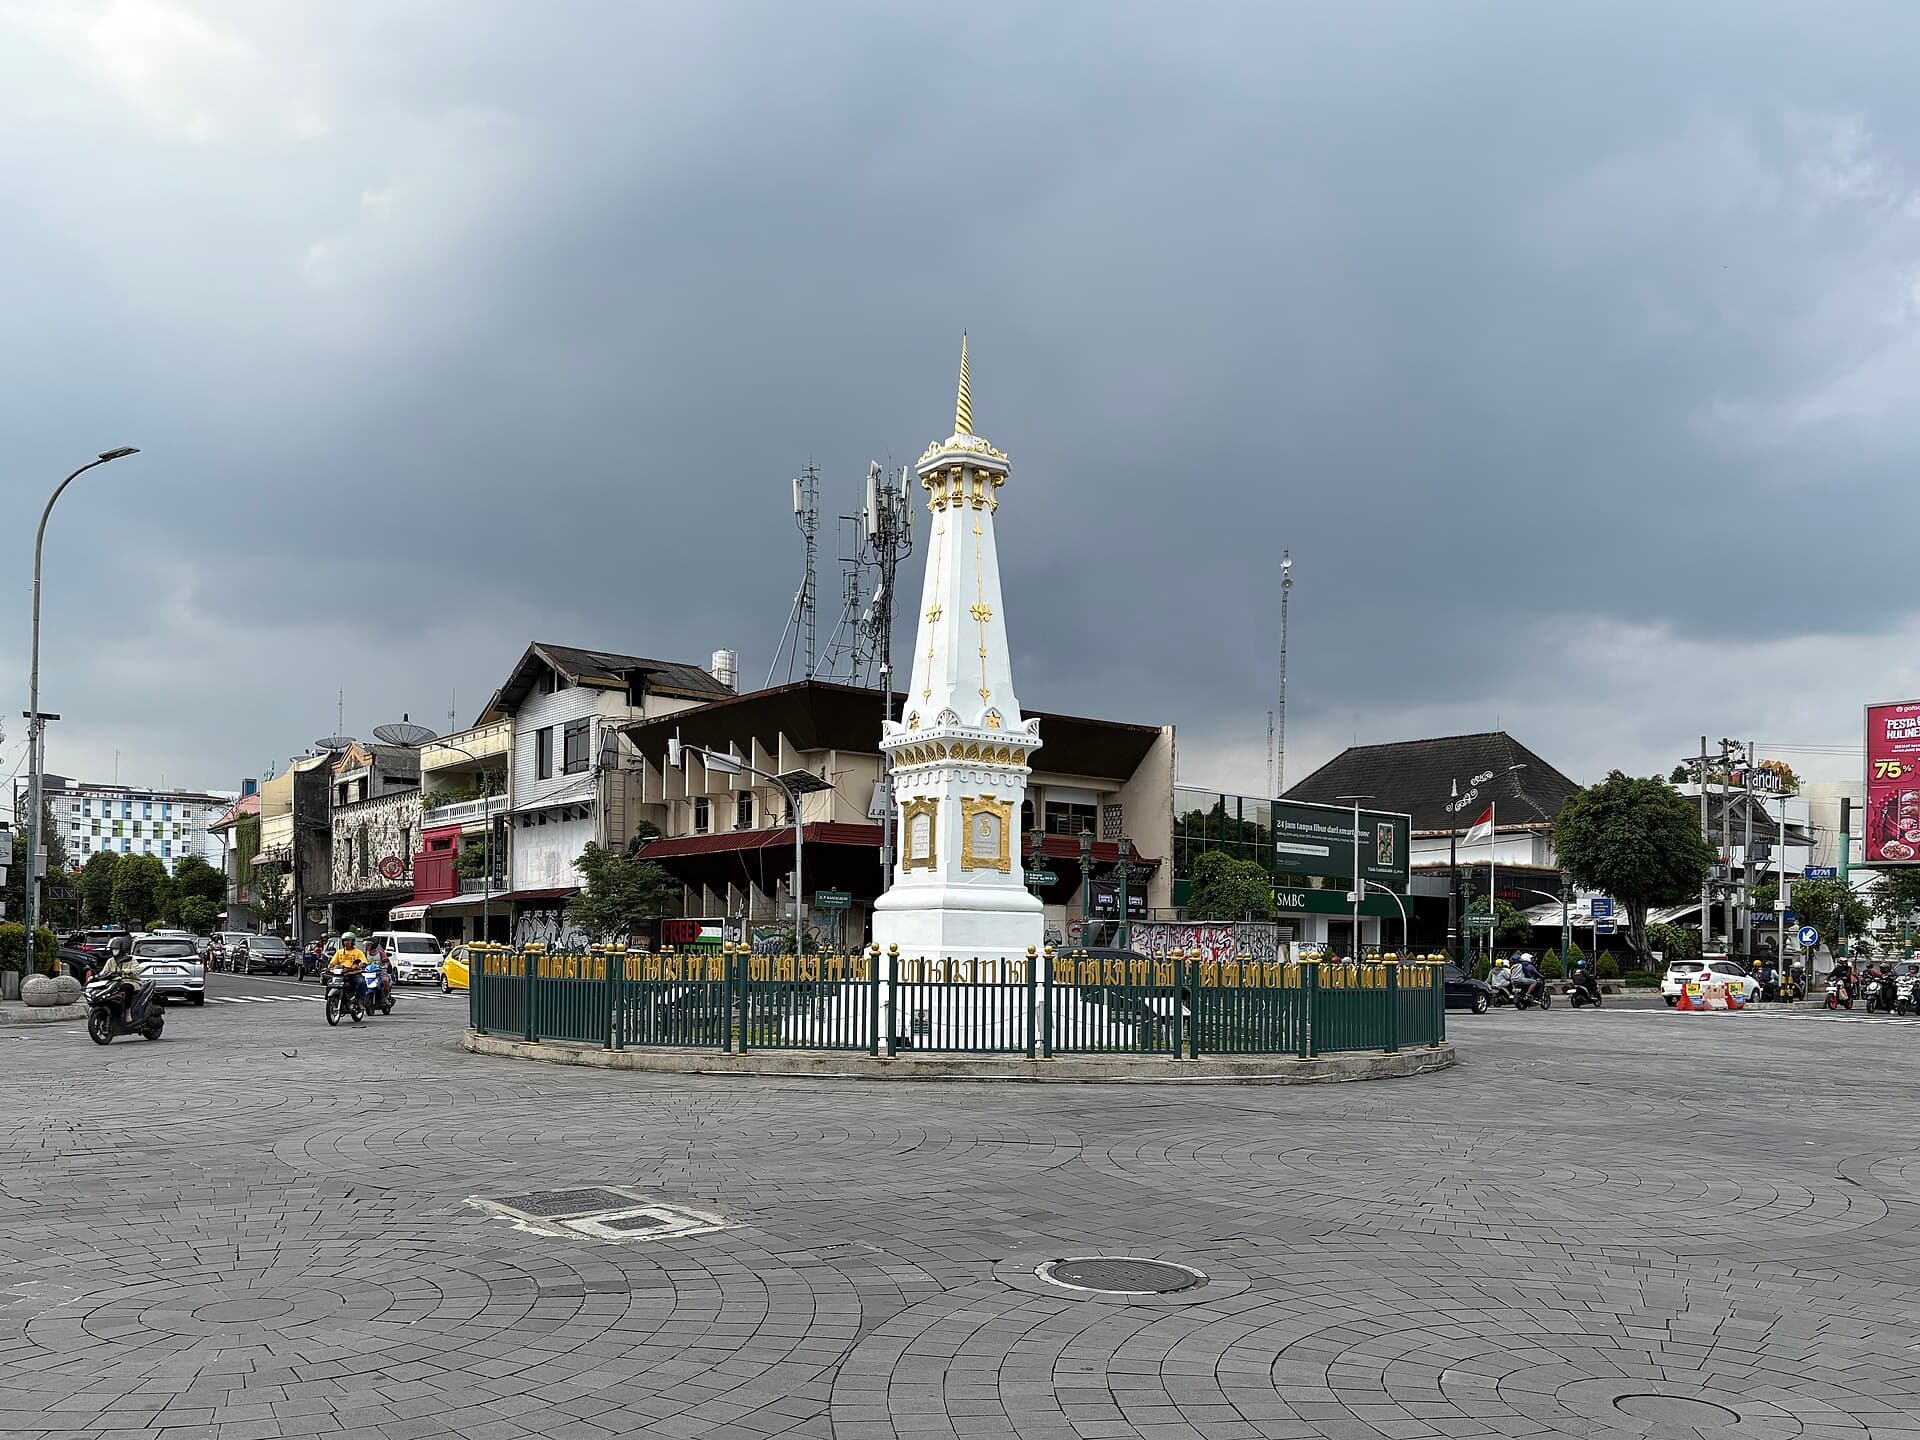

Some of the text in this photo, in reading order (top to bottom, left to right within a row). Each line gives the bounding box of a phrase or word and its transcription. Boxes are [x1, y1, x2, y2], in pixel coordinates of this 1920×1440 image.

[1887, 718, 1916, 730] PESTA
[1276, 819, 1285, 828] 24
[1284, 820, 1296, 830] jam
[1296, 822, 1313, 832] tanpa
[1313, 823, 1327, 832] libur
[1327, 825, 1339, 834] dari
[1277, 892, 1305, 908] SMBC
[663, 920, 693, 944] FREE
